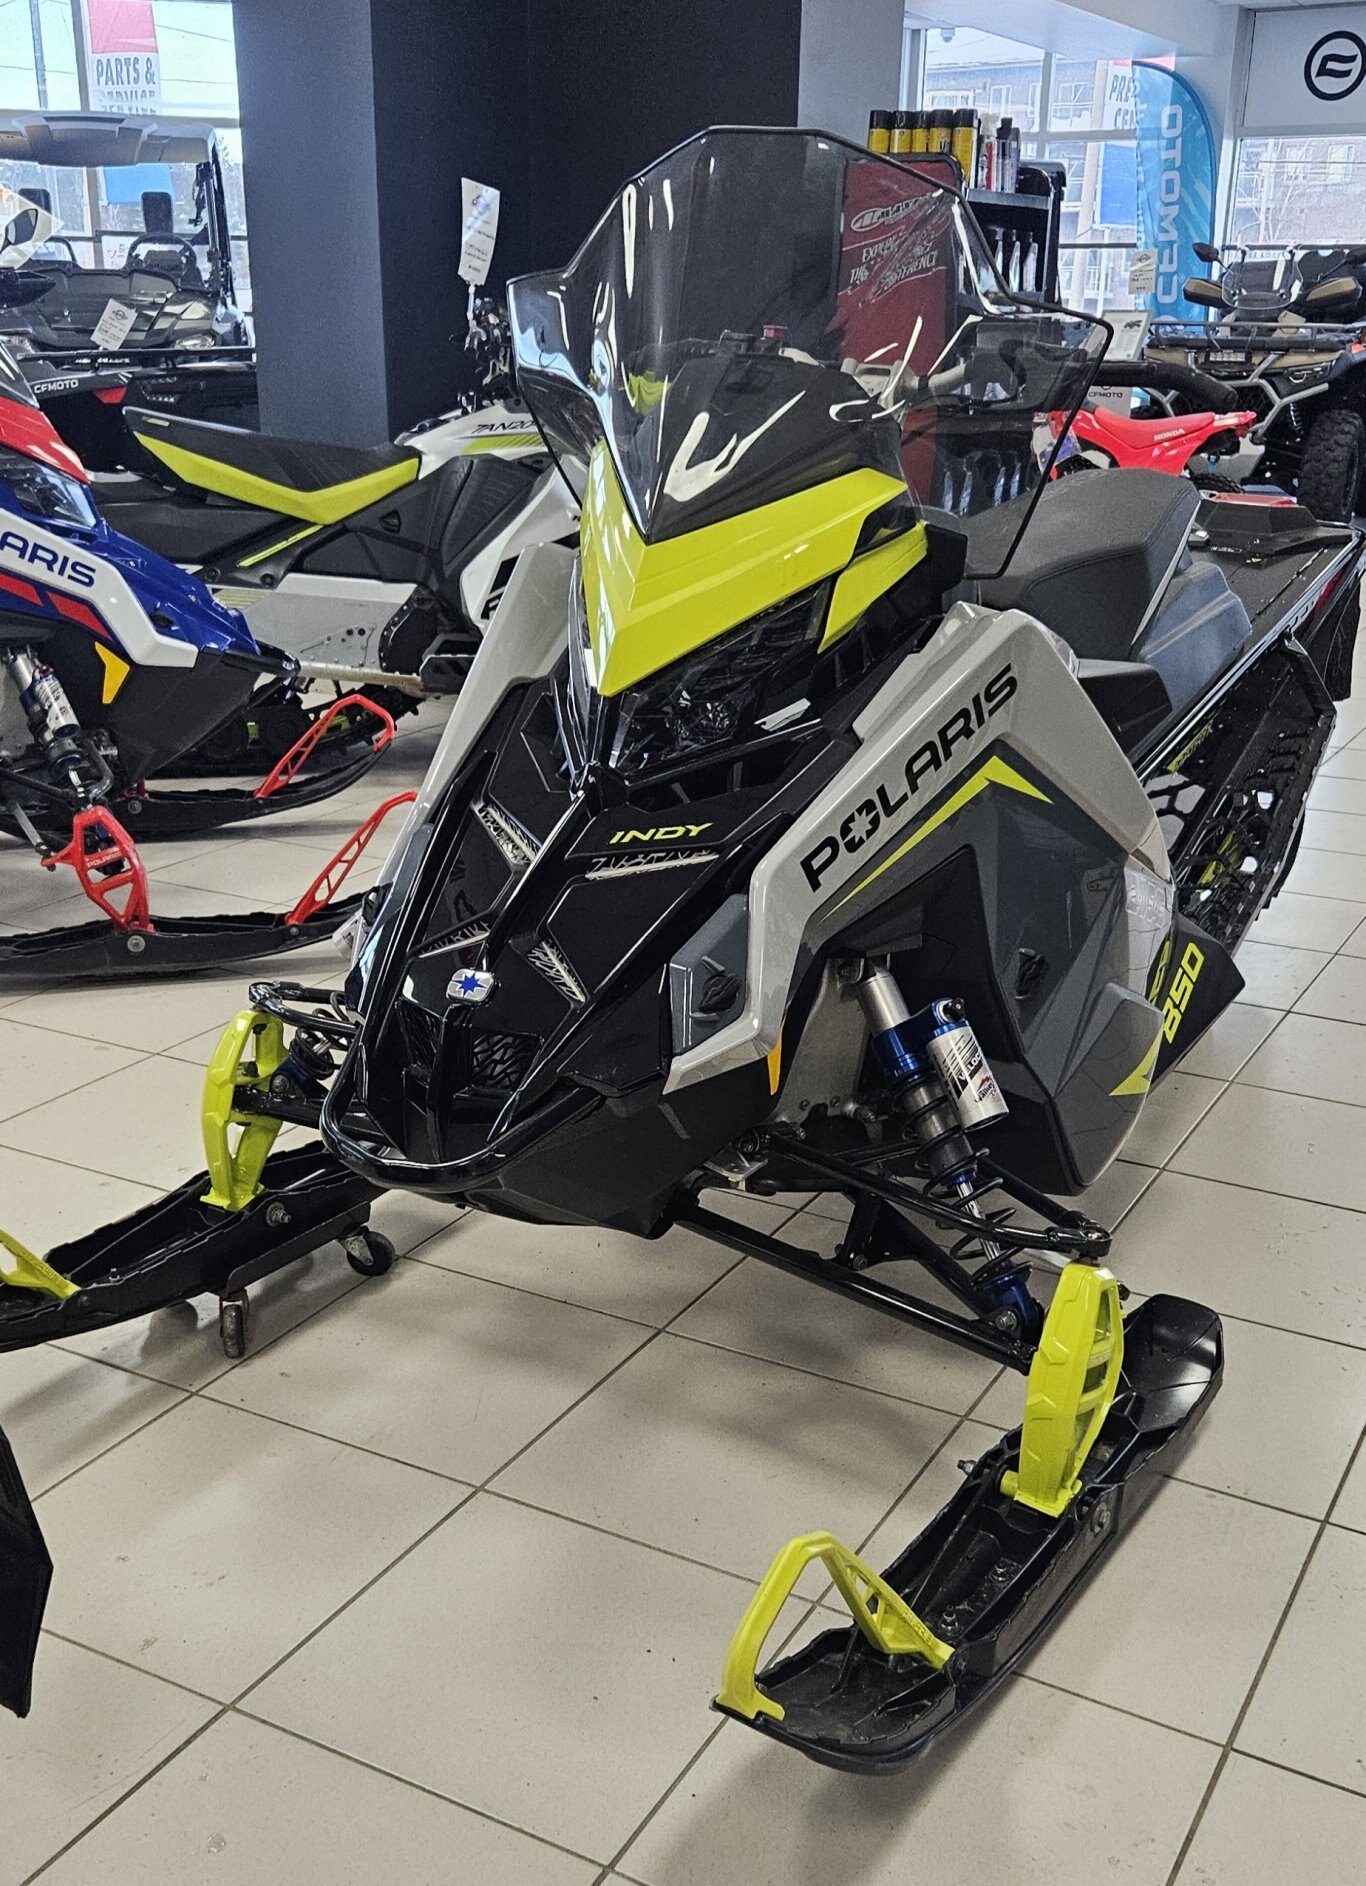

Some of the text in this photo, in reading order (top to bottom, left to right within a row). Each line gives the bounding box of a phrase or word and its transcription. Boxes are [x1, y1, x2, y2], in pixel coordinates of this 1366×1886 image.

[96, 57, 156, 86] PARTS &
[33, 379, 79, 394] CFMOTO
[1088, 391, 1123, 399] CFMOTO
[1153, 428, 1186, 441] HONDA
[0, 531, 97, 588] ARIS
[800, 662, 1018, 893] POLARIS
[609, 822, 715, 845] INDY
[1161, 942, 1205, 1045] 850
